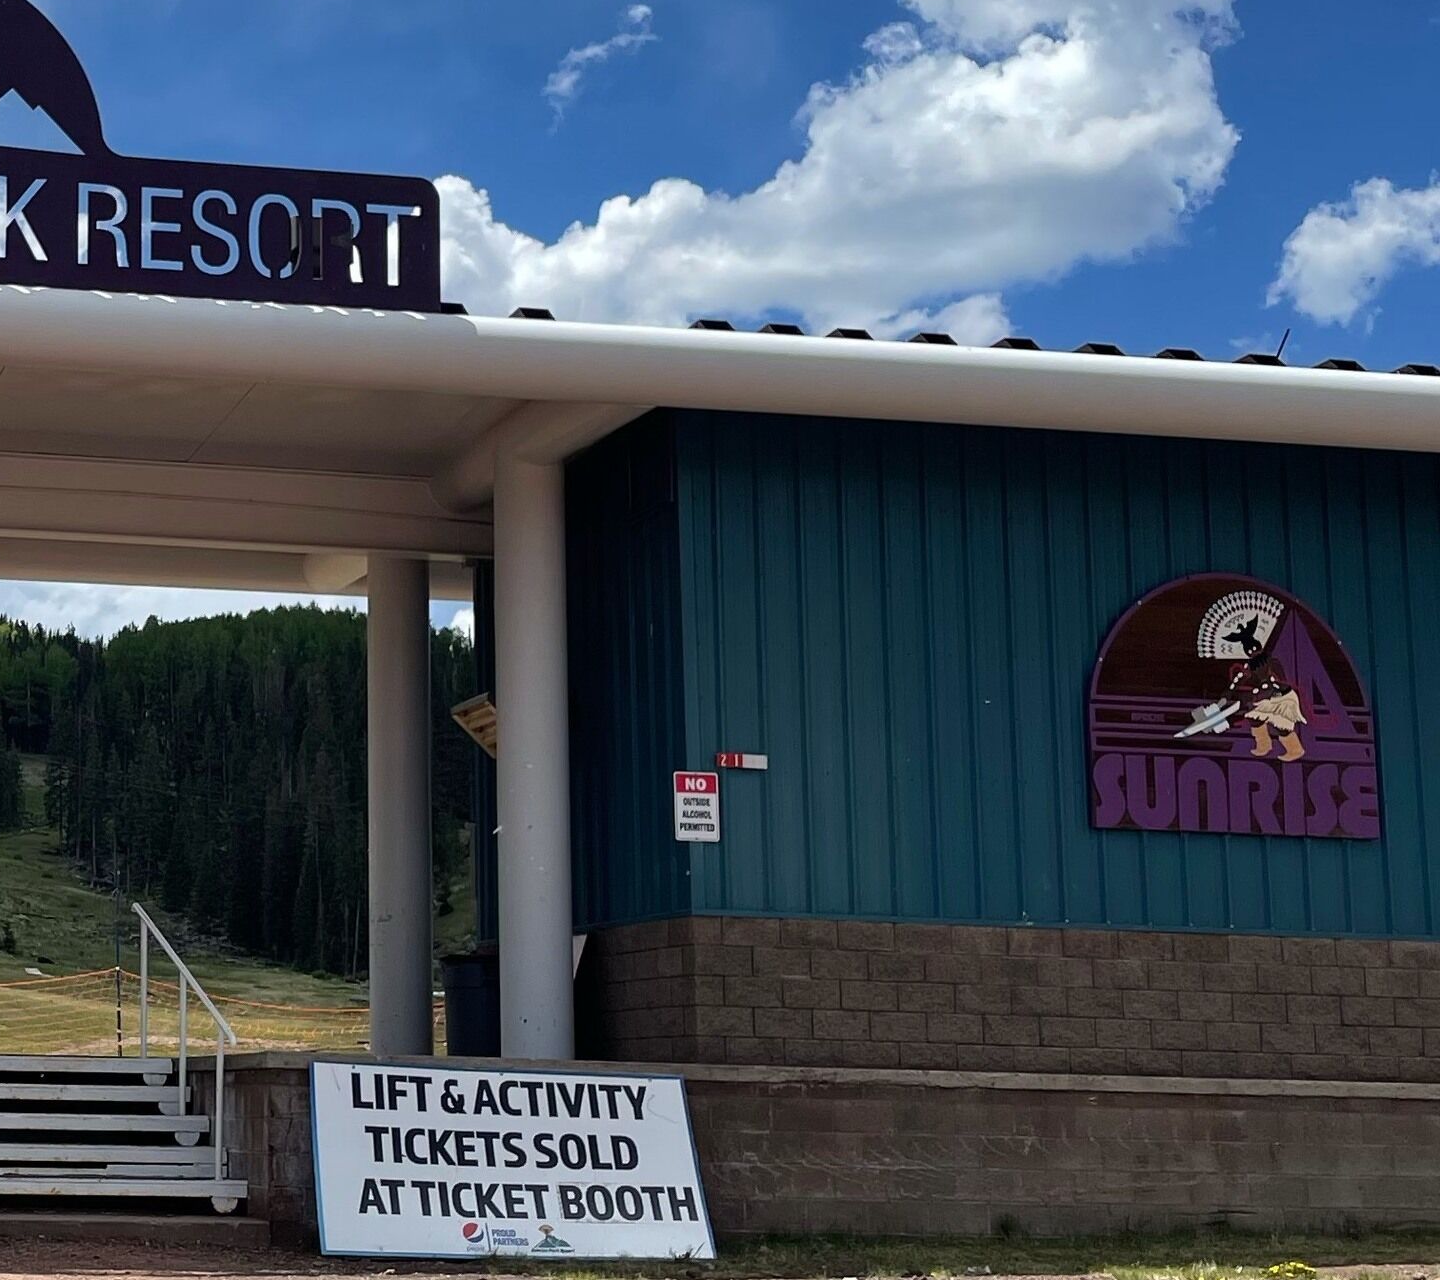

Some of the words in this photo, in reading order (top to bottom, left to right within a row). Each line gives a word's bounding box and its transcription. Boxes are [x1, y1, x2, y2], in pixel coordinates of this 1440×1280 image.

[77, 182, 421, 287] RESORT
[683, 797, 711, 807] OUTSIDE
[685, 778, 707, 791] NO
[1092, 753, 1379, 838] SUNRISE
[679, 823, 715, 832] PERMITTED
[682, 810, 712, 820] ALCOHOL
[351, 1072, 432, 1112] LIFT
[441, 1079, 465, 1115] &
[474, 1080, 646, 1120] ACTIVITY
[365, 1126, 527, 1168] TICKETS
[534, 1133, 639, 1170] SOLD
[359, 1178, 404, 1215] AT
[411, 1180, 549, 1219] TICKET
[560, 1185, 699, 1222] BOOTH
